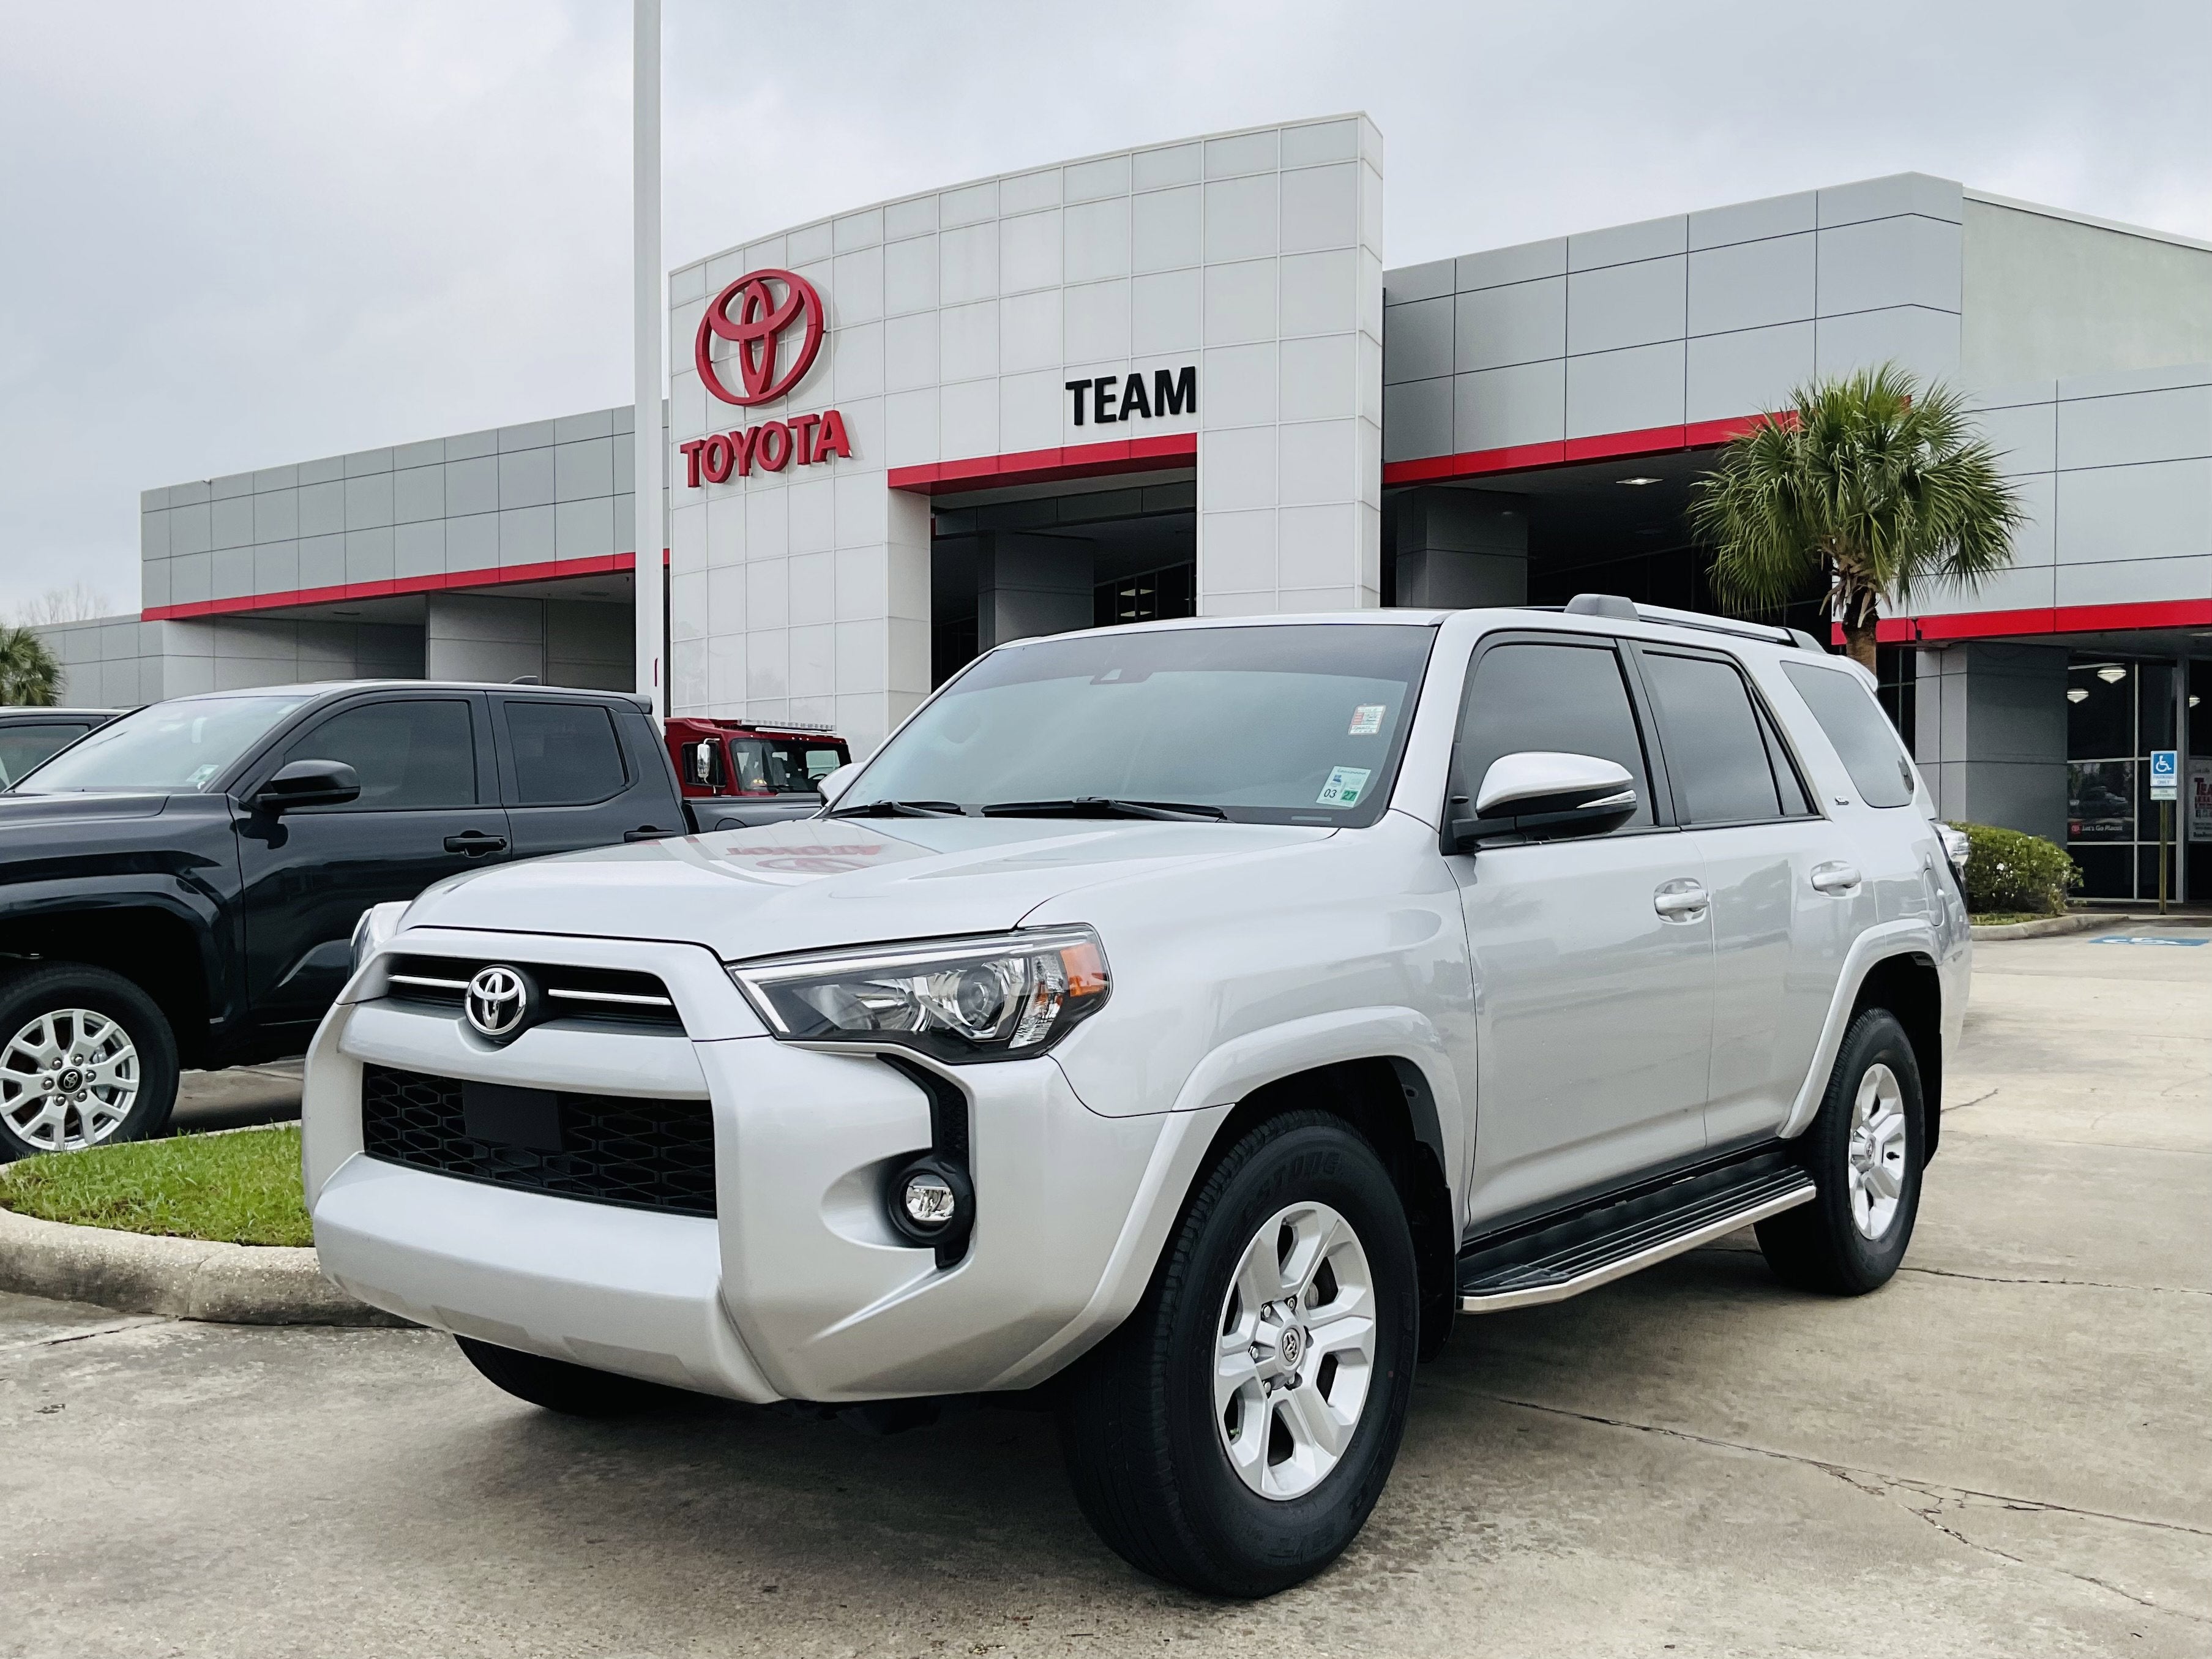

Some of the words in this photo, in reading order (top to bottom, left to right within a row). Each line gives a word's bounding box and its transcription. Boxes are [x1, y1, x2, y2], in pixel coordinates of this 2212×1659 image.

[1066, 366, 1196, 425] TEAM
[680, 410, 852, 488] TOYOTA
[1324, 788, 1337, 798] 03
[1341, 790, 1358, 800] 27
